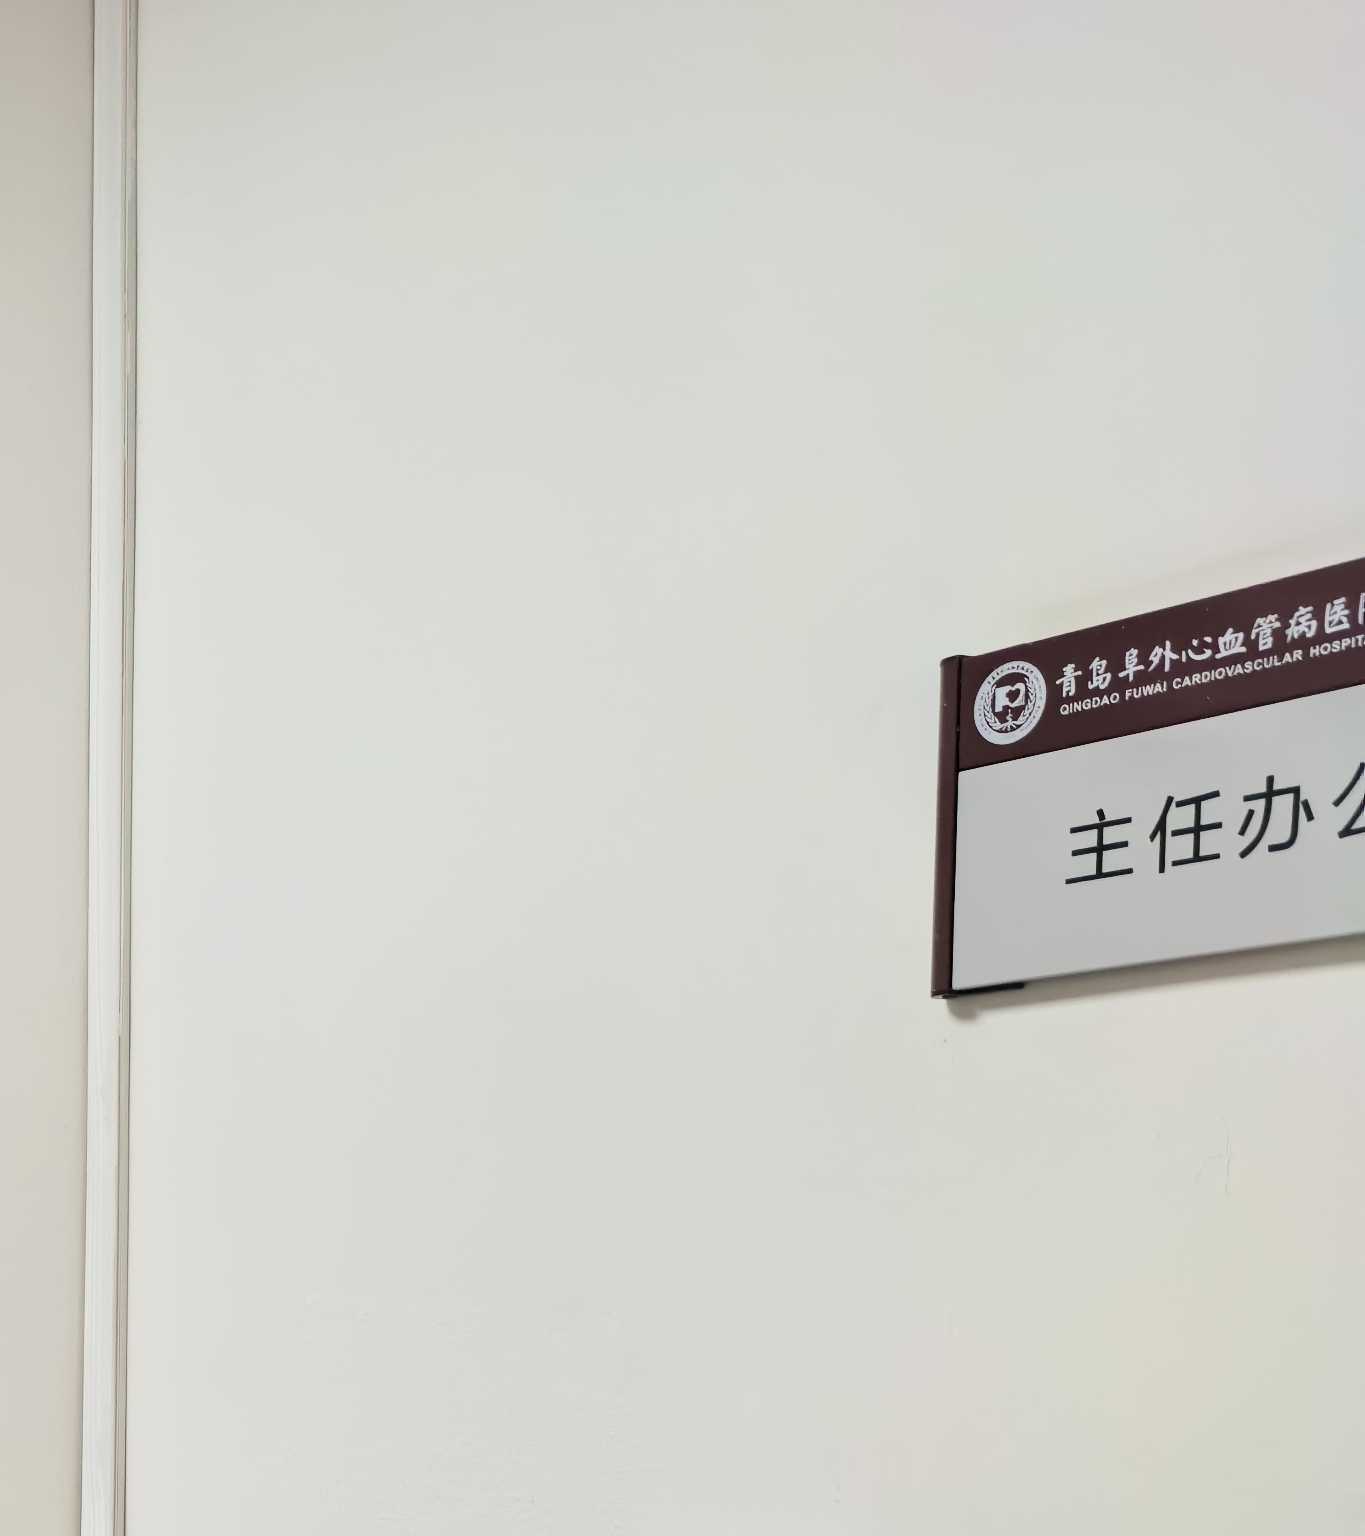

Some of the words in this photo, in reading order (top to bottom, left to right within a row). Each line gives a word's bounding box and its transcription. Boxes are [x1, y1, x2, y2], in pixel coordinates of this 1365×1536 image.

[1055, 592, 1365, 698] 青岛阜外心血管病医
[1060, 692, 1120, 715] QINGDAO
[1125, 680, 1168, 701] FUWAI
[1172, 649, 1303, 690] CARDIOVASCULAR
[1310, 634, 1365, 658] HOSPIT
